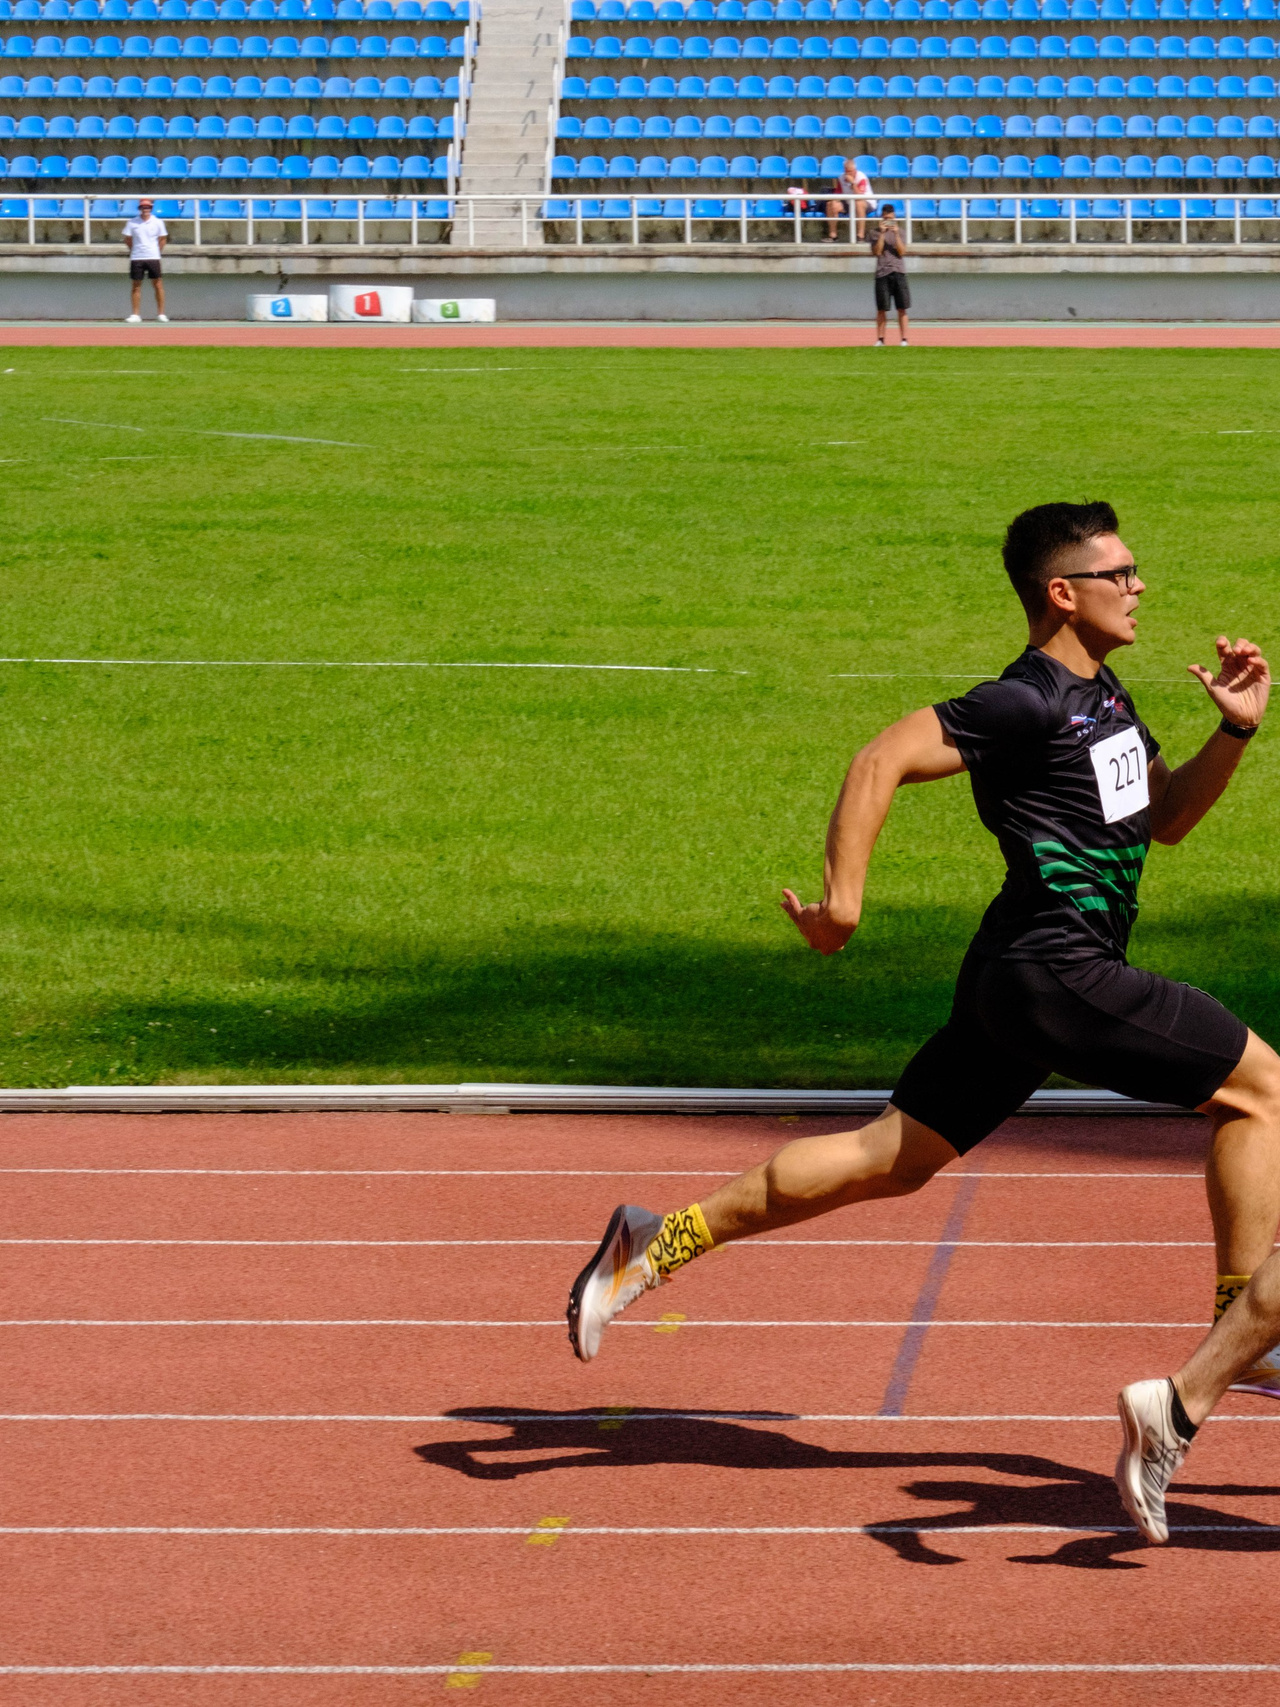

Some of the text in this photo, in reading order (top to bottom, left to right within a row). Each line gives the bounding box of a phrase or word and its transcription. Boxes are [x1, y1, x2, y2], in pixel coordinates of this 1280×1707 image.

[276, 301, 286, 313] 2
[363, 295, 371, 311] 1
[445, 303, 454, 315] 3
[1109, 746, 1141, 792] 227
